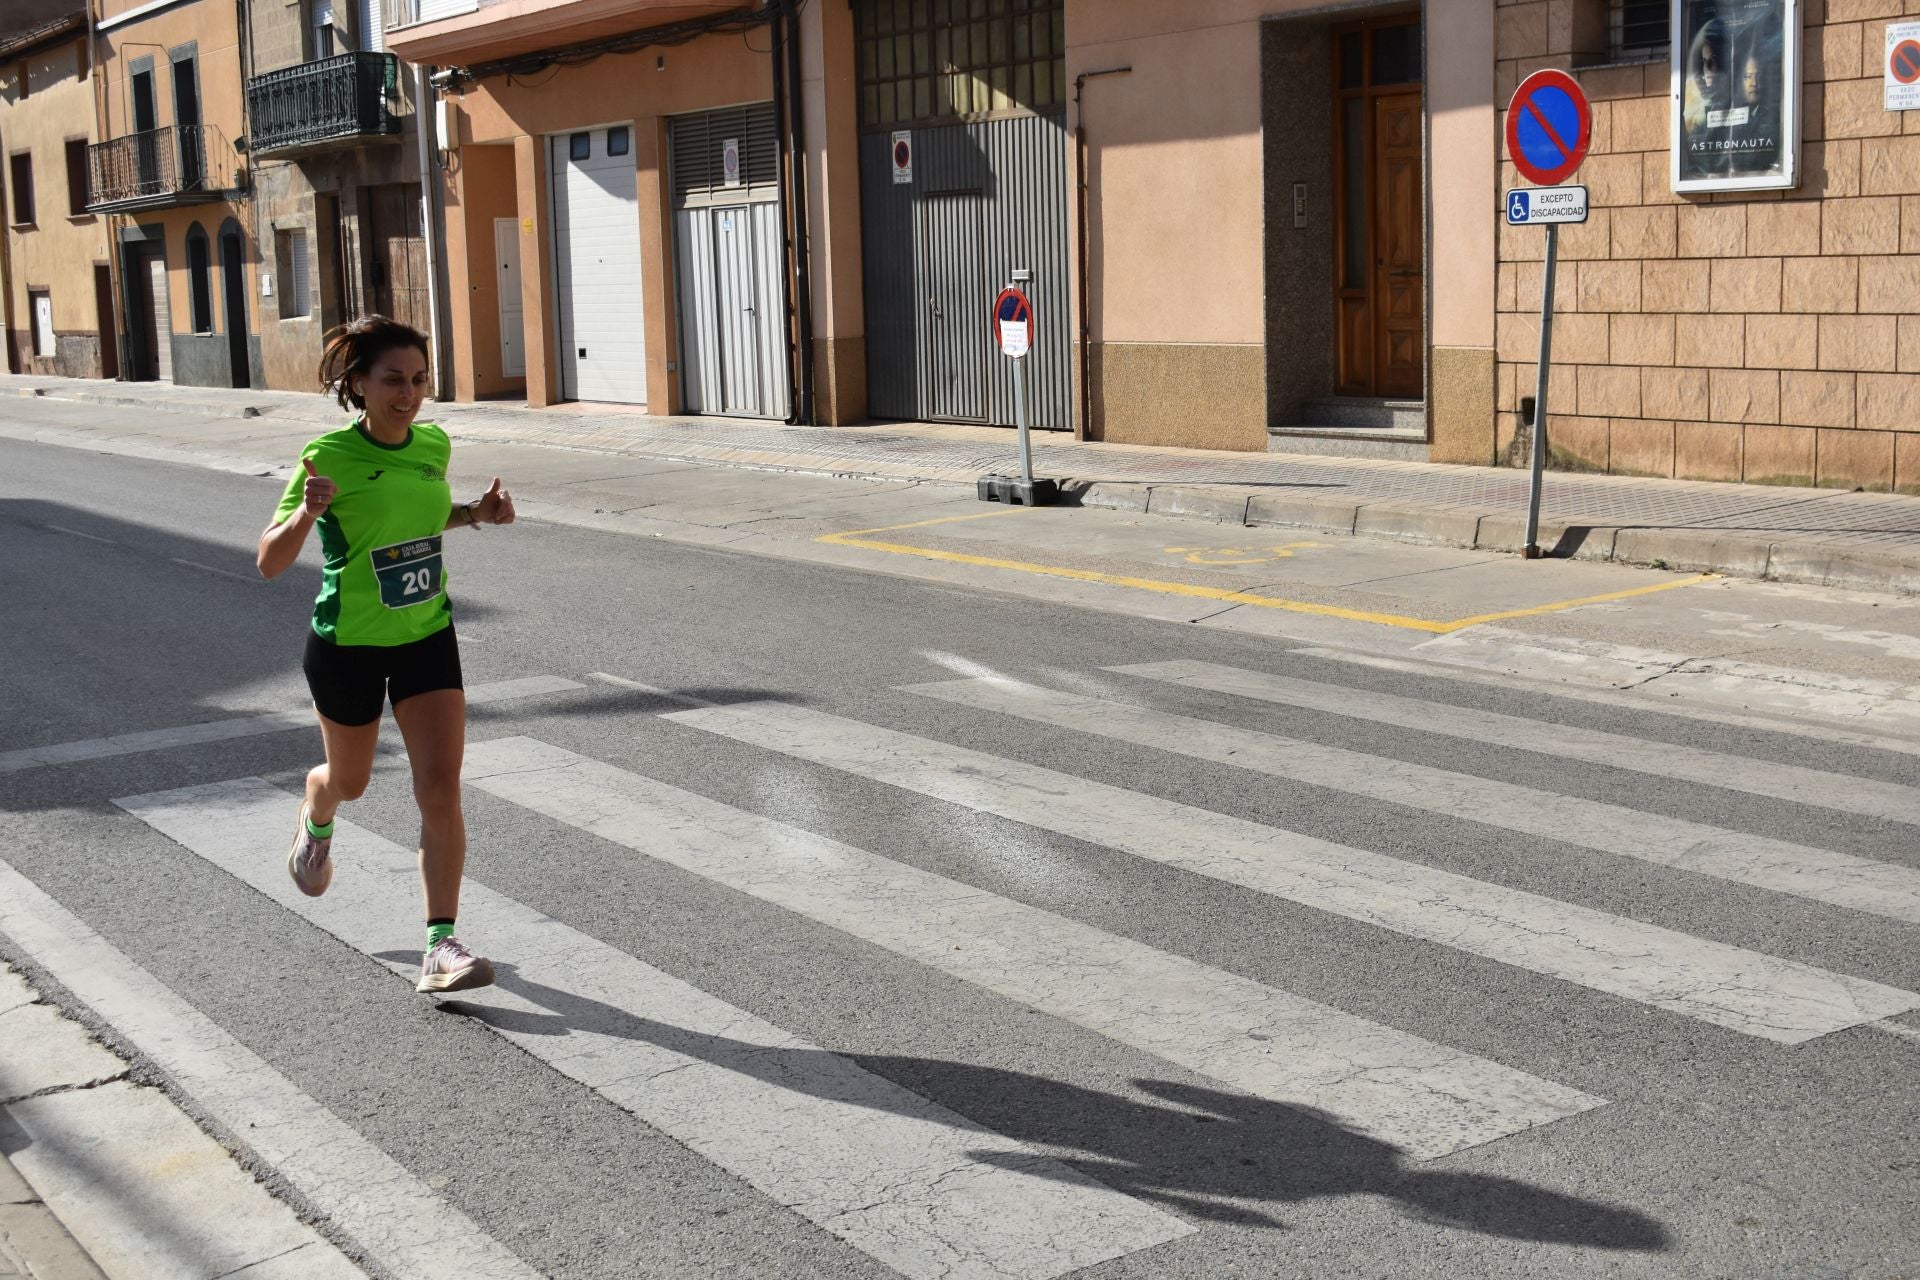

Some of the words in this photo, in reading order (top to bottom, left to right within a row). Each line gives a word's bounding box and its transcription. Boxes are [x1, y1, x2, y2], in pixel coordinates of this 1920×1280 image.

[1888, 93, 1920, 101] PERMANEN
[1691, 138, 1774, 151] ASTRONAUTA
[1540, 193, 1573, 204] EXCEPTO
[1531, 207, 1584, 218] DISCAPACIDAD
[402, 567, 430, 596] 20
